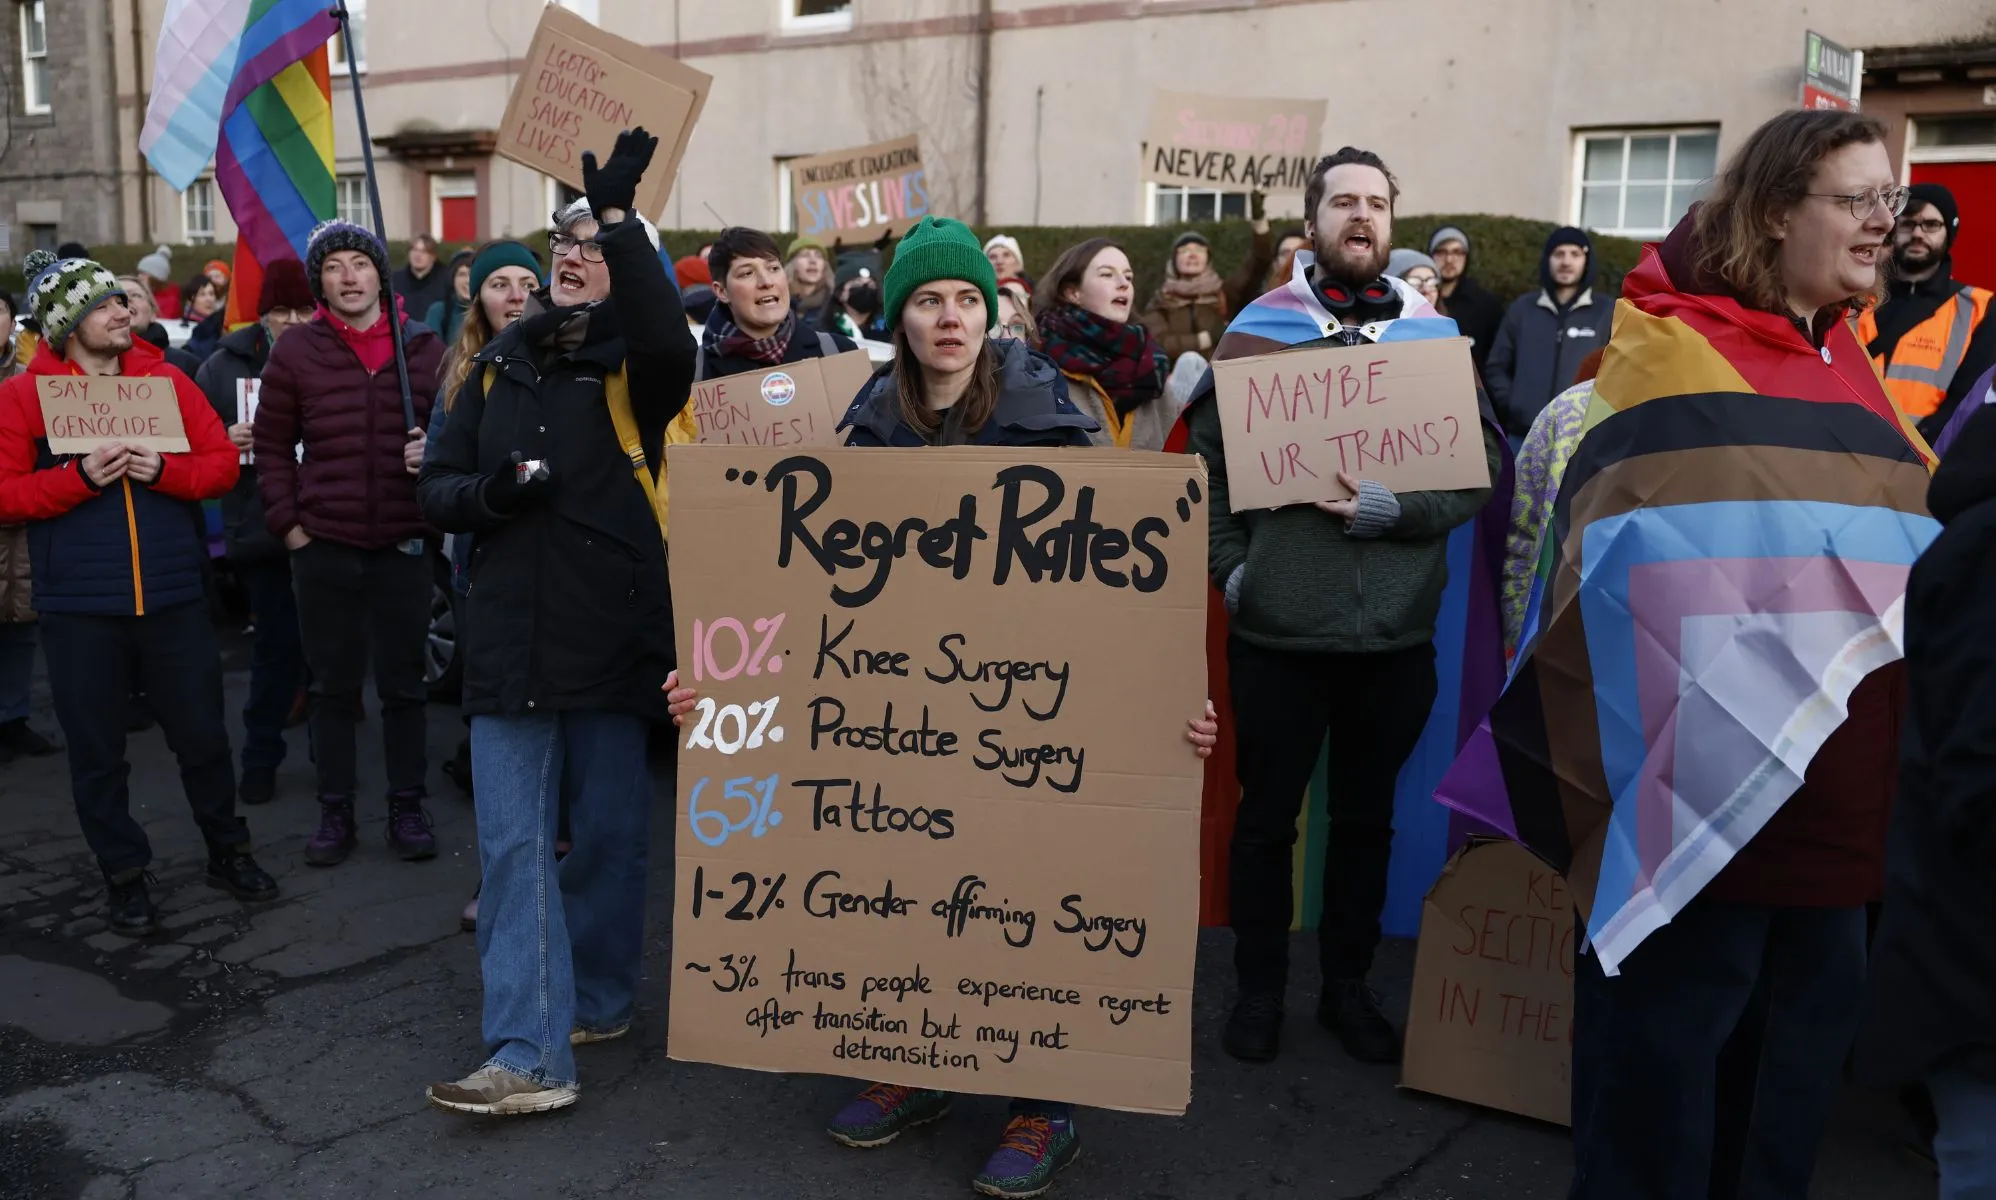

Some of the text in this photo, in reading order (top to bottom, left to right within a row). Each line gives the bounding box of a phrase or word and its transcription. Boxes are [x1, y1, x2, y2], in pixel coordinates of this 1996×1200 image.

[528, 97, 583, 139] SAVES
[537, 70, 634, 126] EDUCATION
[1154, 146, 1317, 189] NEVER AGAIN
[48, 380, 152, 401] SAY NO
[89, 403, 110, 415] TO
[1246, 360, 1389, 433] MAYBE
[52, 416, 162, 438] GENOCIDE
[1261, 416, 1459, 486] UR TRANS?
[694, 612, 1069, 722] 10% Knee Surgery
[686, 696, 1084, 793] 20% Prostate Surgery
[689, 774, 954, 846] 65% Tattoos
[693, 866, 1146, 958] 1-2% Gender affirming Surgery
[781, 949, 845, 994] trans
[861, 964, 932, 1003] people
[958, 977, 1080, 1006] experience
[1099, 993, 1171, 1025] regret
[1439, 977, 1480, 1027] IN
[1499, 993, 1561, 1042] THE
[746, 998, 1069, 1063] after transition but may not
[833, 1036, 980, 1071] detransition
